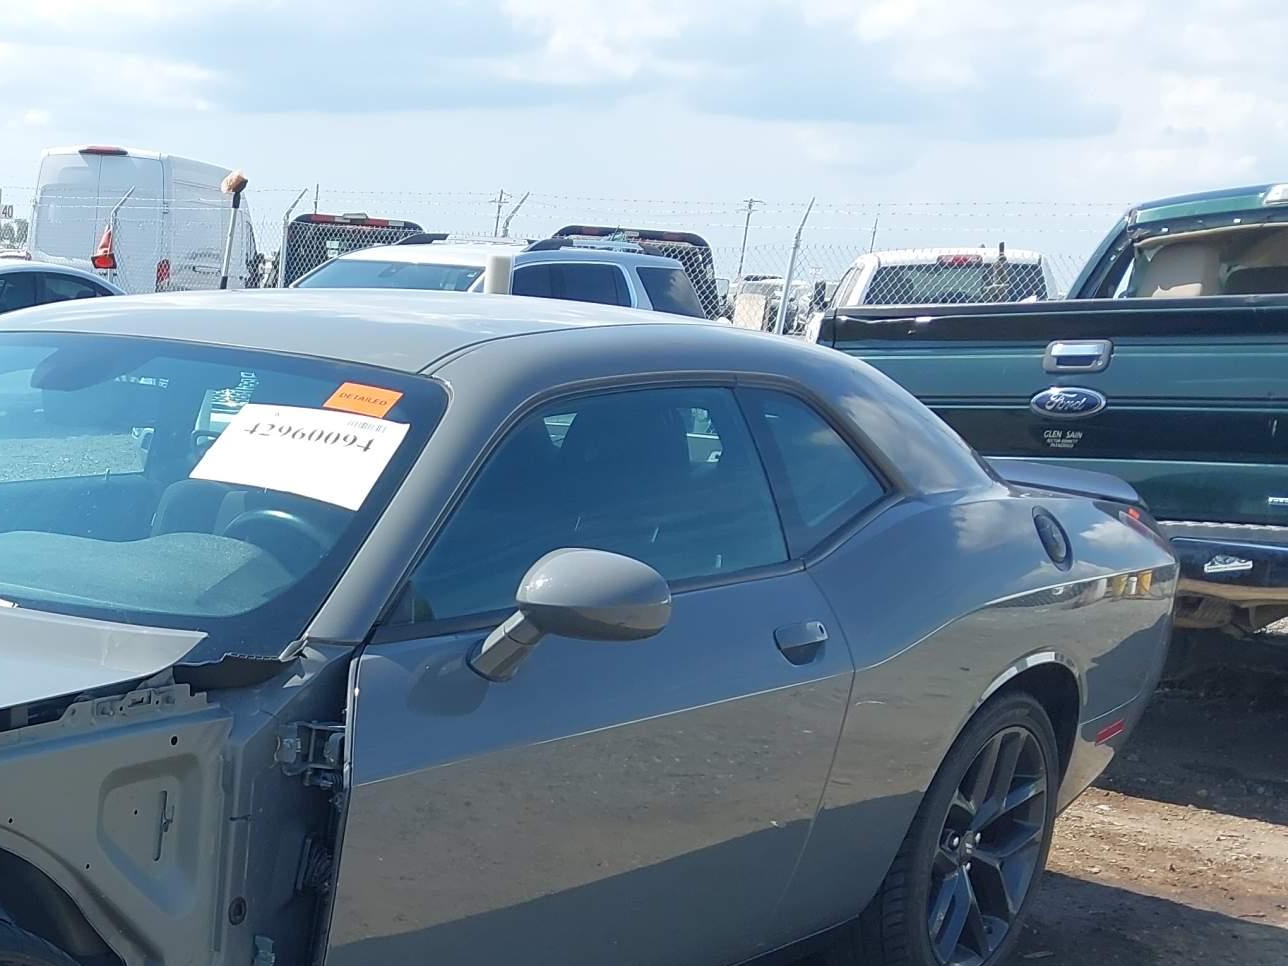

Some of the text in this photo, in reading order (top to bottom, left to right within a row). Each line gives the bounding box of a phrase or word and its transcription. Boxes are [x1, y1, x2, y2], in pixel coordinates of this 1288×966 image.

[1, 205, 14, 218] 40
[338, 391, 388, 407] DETAILED
[1045, 393, 1087, 411] Ford
[246, 423, 375, 452] 42960094
